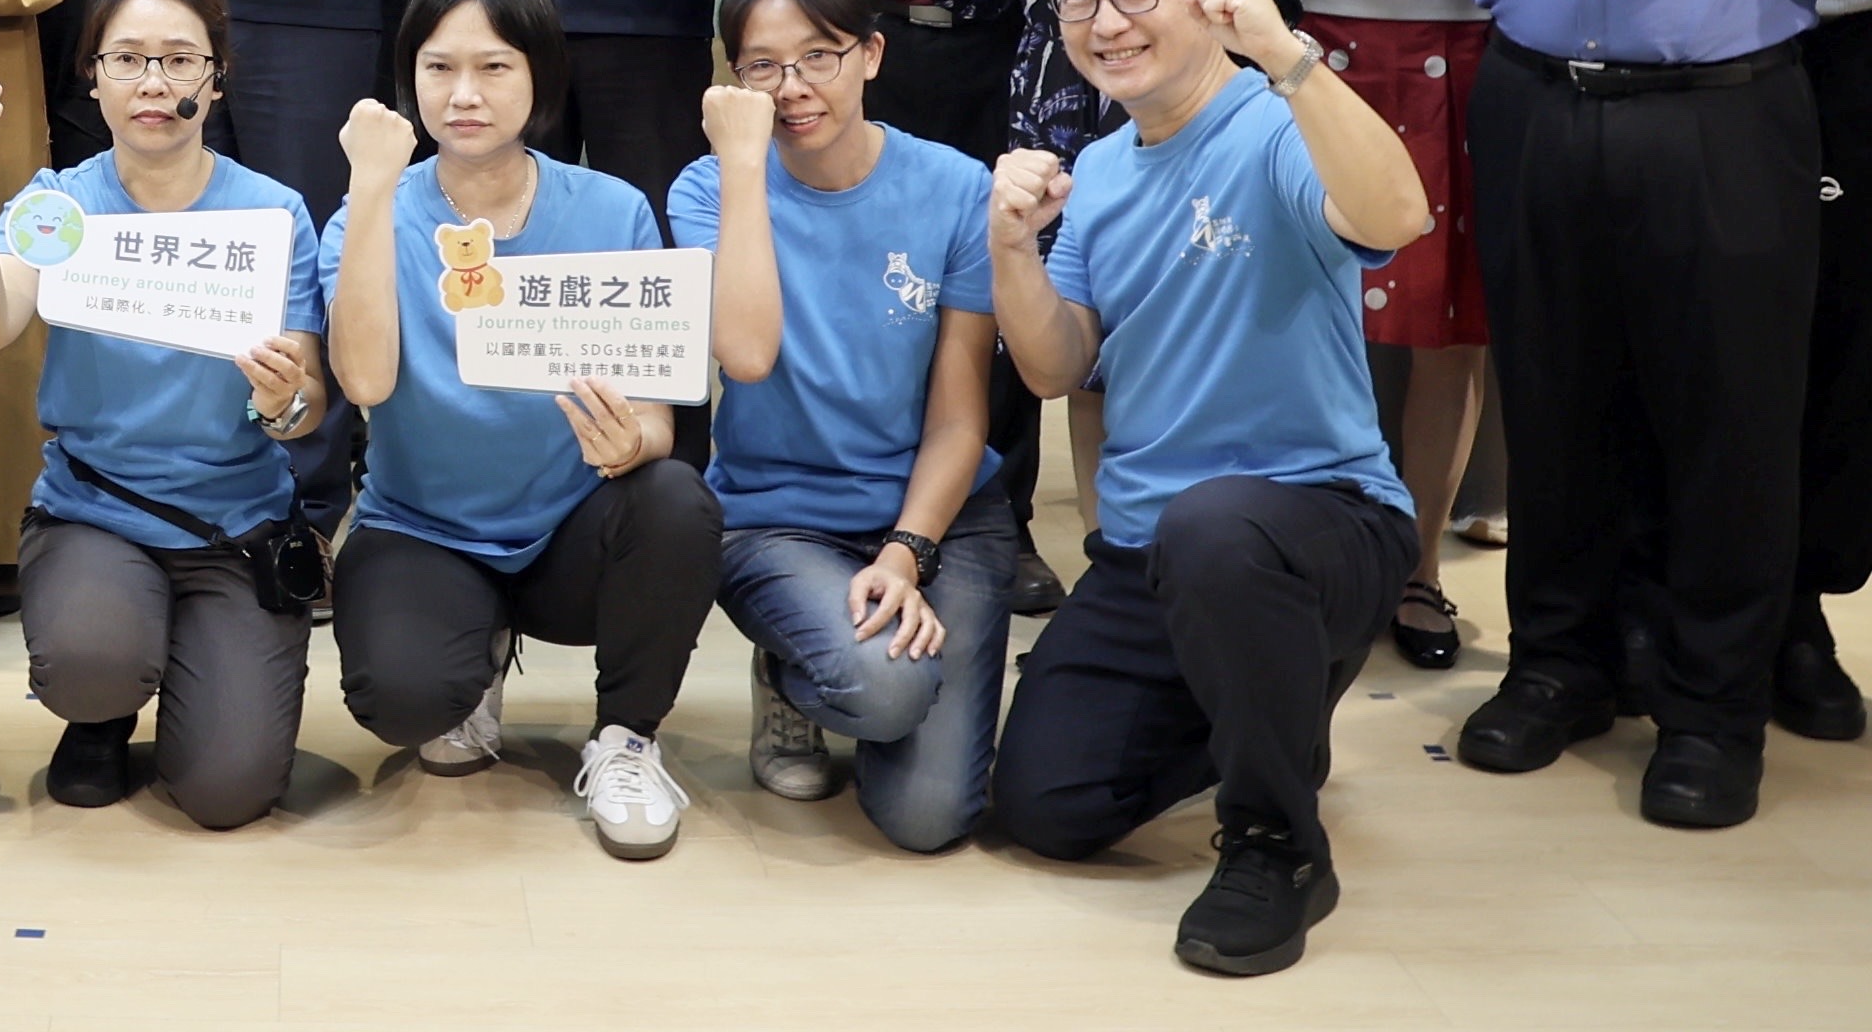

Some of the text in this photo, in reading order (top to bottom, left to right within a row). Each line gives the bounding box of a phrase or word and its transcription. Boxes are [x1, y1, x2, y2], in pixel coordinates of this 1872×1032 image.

[114, 231, 257, 272] 世界之旅
[62, 269, 255, 299] Journey around World
[519, 275, 673, 309] 遊戲之旅
[85, 296, 254, 325] 以國際化、多元化為主軸
[476, 315, 691, 334] Journey through Games
[548, 362, 673, 377] 與科普市集為主軸
